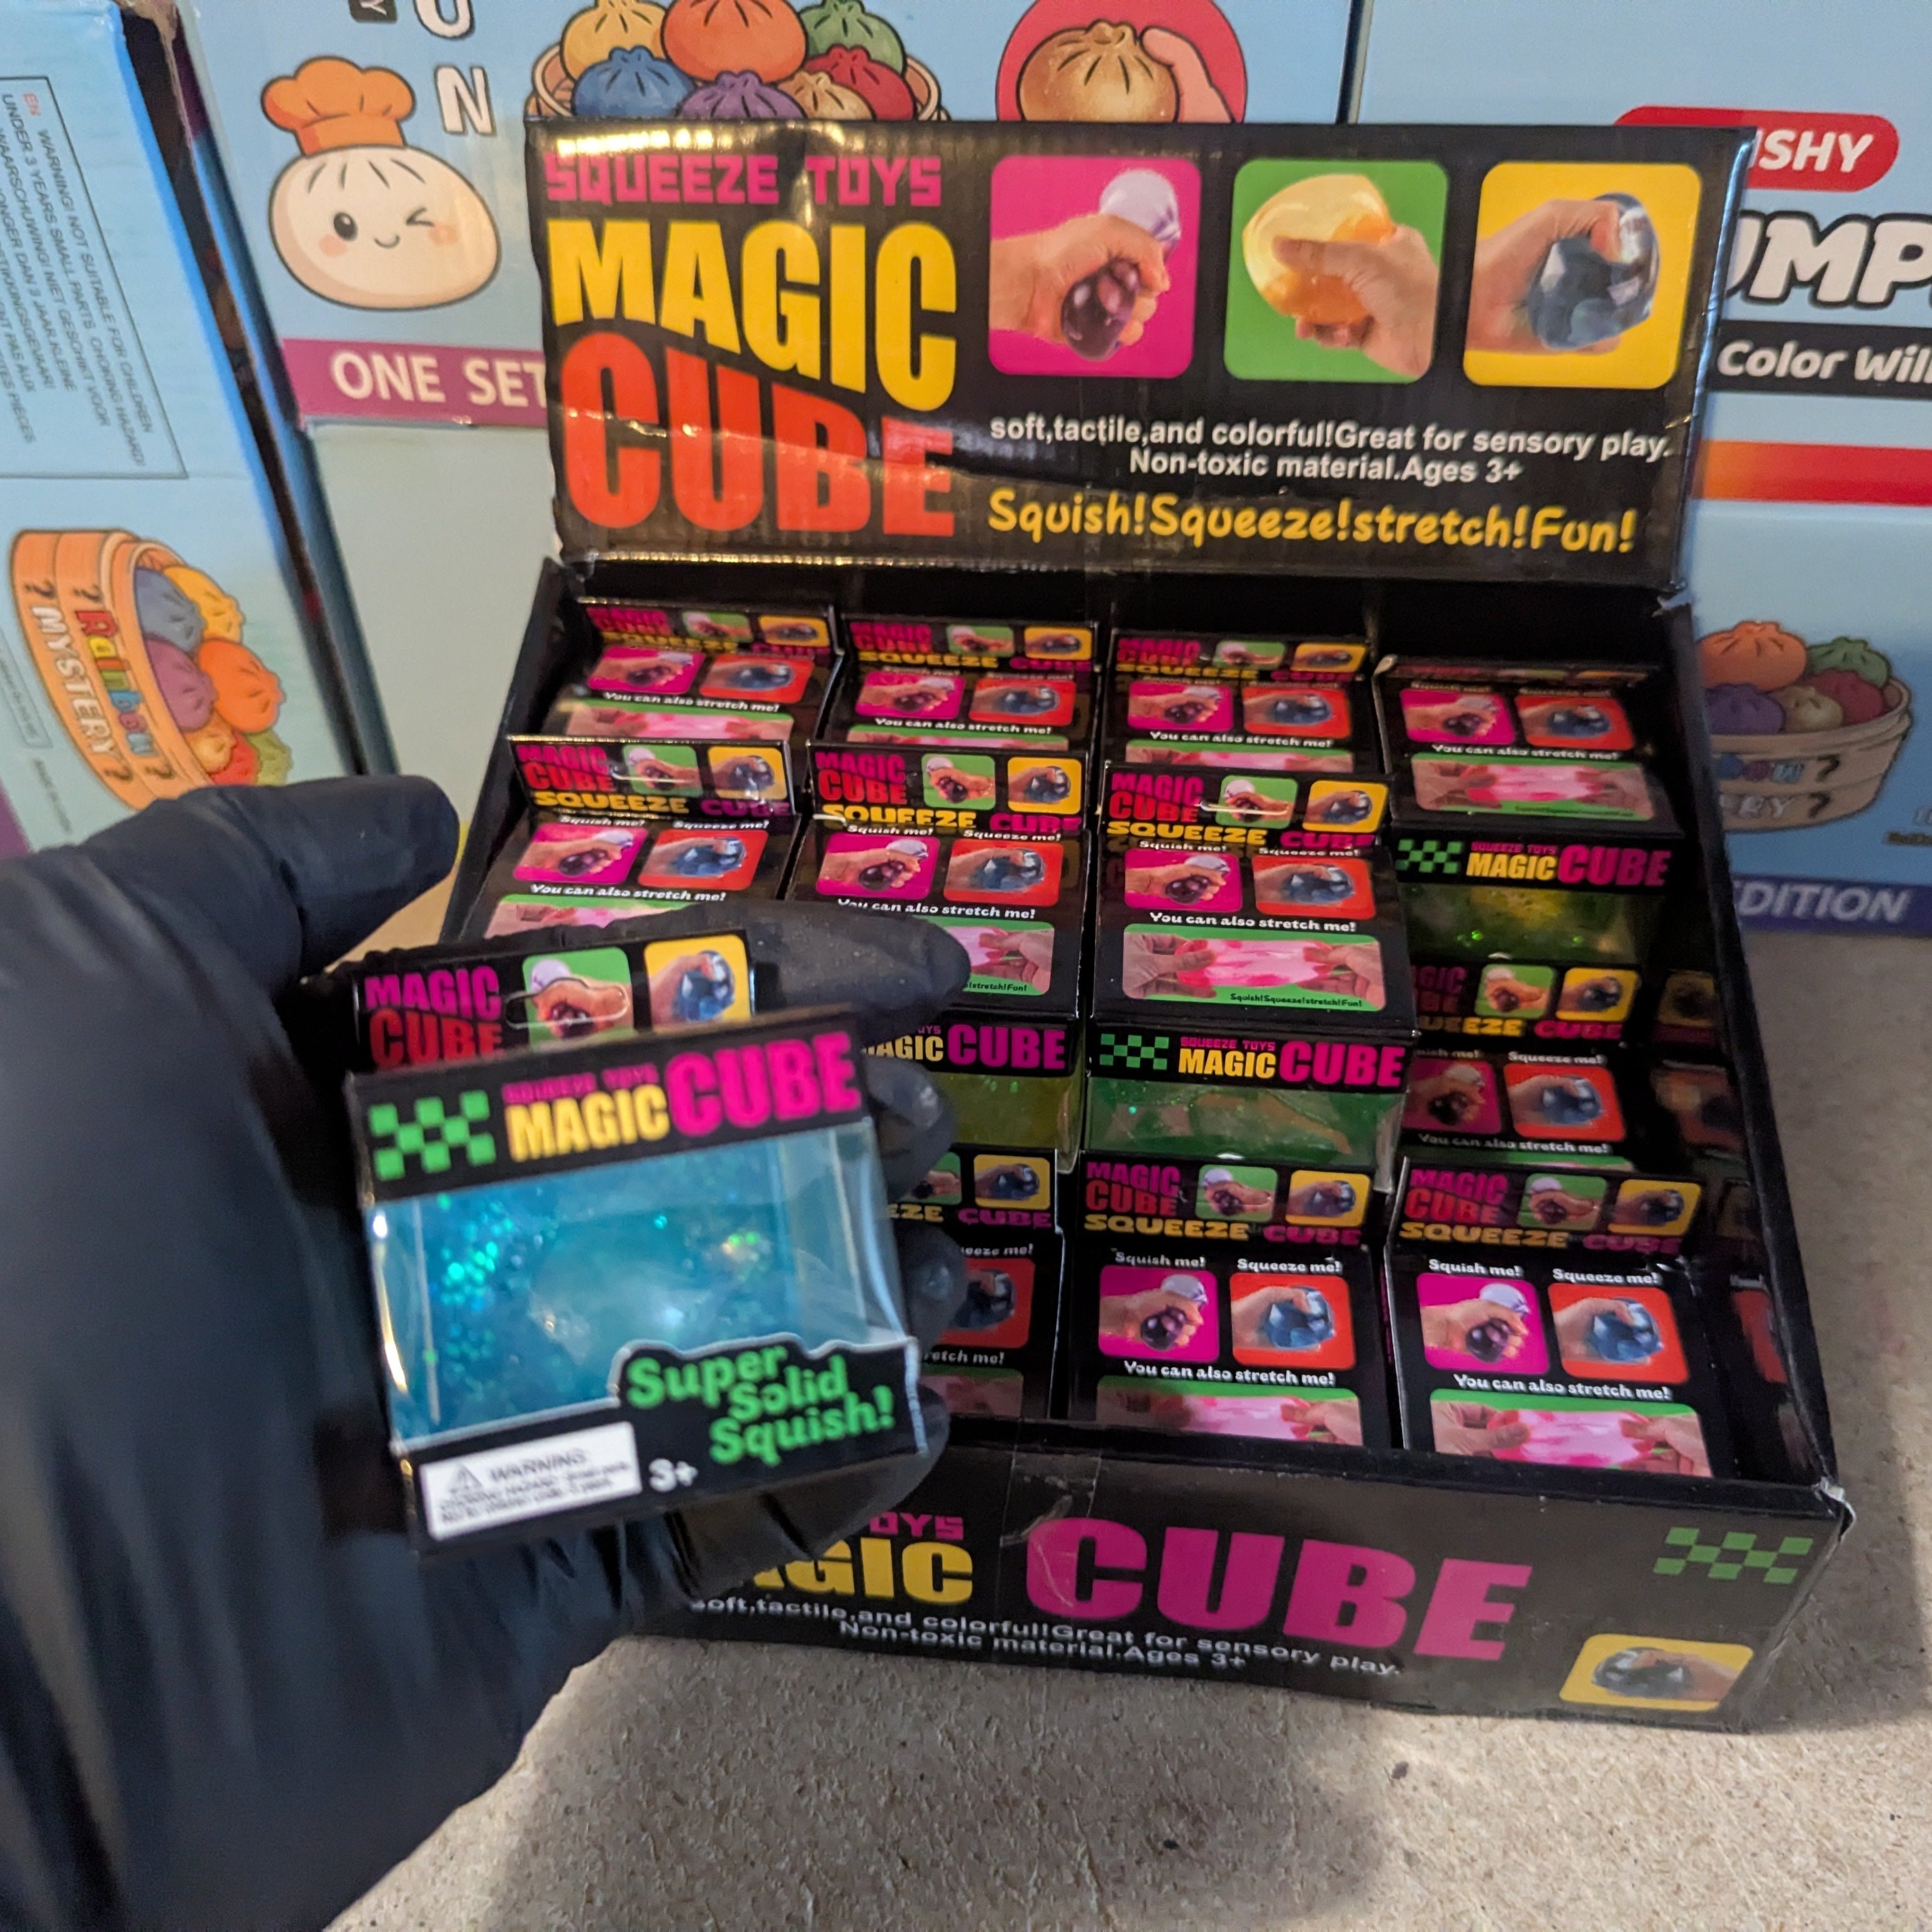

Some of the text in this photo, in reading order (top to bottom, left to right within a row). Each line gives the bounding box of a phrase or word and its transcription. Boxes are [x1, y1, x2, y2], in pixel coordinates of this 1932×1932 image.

[3, 94, 33, 152] UNDER
[544, 153, 941, 206] SQUEEZE TOYS
[68, 215, 89, 248] NOT
[547, 219, 957, 411] MAGIC
[1717, 340, 1849, 379] Color
[331, 350, 547, 408] ONE SET
[560, 331, 955, 536] CUBE
[1423, 422, 1468, 450] for
[1472, 431, 1597, 461] sensory
[1599, 430, 1674, 462] play.
[1130, 446, 1270, 476] Non-toxic
[1485, 458, 1524, 484] 3+
[31, 606, 116, 755] MYSTERY
[516, 745, 608, 774] MAGIC
[816, 753, 905, 782] MAGIC
[523, 762, 615, 792] CUBE
[818, 769, 907, 804] CUBE
[1111, 774, 1203, 806] MAGIC
[533, 792, 689, 813] SQUEEZE
[822, 804, 1081, 833] SQUEEZE CUBE
[1109, 791, 1199, 822] CUBE
[1107, 821, 1267, 845] SQUEEZE
[1466, 845, 1672, 886] MAGIC CUBE
[530, 884, 725, 902] You can also stretch me!
[1733, 882, 1911, 923] DITION
[871, 901, 1035, 919] can also stretch me!
[1150, 913, 1356, 932] You can also stretch me!
[365, 965, 501, 1018] MAGIC
[369, 1008, 502, 1068] CUBE
[947, 1024, 1065, 1069] CUBE
[1180, 1036, 1276, 1052] SQUEEZE TOYS
[1535, 1021, 1624, 1040] CUBE
[1178, 1041, 1405, 1087] MAGIC CUBE
[504, 1031, 861, 1163] MAGIC CUBE
[1518, 1141, 1575, 1153] stretch
[1086, 1162, 1180, 1197] MAGIC
[1409, 1169, 1507, 1205] MAGIC
[1085, 1180, 1177, 1217] CUBE
[1403, 1187, 1499, 1224] CUBE
[958, 1209, 1052, 1228] CUBE
[1084, 1214, 1362, 1246] SQUEEZE CUBE
[1399, 1222, 1681, 1255] SQUEEZE CUBE
[1114, 1252, 1206, 1268] Squish me!
[1237, 1258, 1342, 1274] Squeeze me!
[1429, 1259, 1523, 1278] Squish me!
[1553, 1268, 1659, 1286] Squeeze me!
[973, 1352, 1004, 1365] me!
[1124, 1360, 1335, 1385] You can also stretch me!
[627, 1346, 787, 1407] Super
[728, 1355, 848, 1422] Solid
[1454, 1374, 1670, 1401] You can also stretch me!
[711, 1386, 895, 1468] Squish!
[1026, 1517, 1533, 1662] CUBE
[1145, 1632, 1187, 1649] for
[1197, 1637, 1321, 1665] sensory
[1211, 1653, 1246, 1670] 3+
